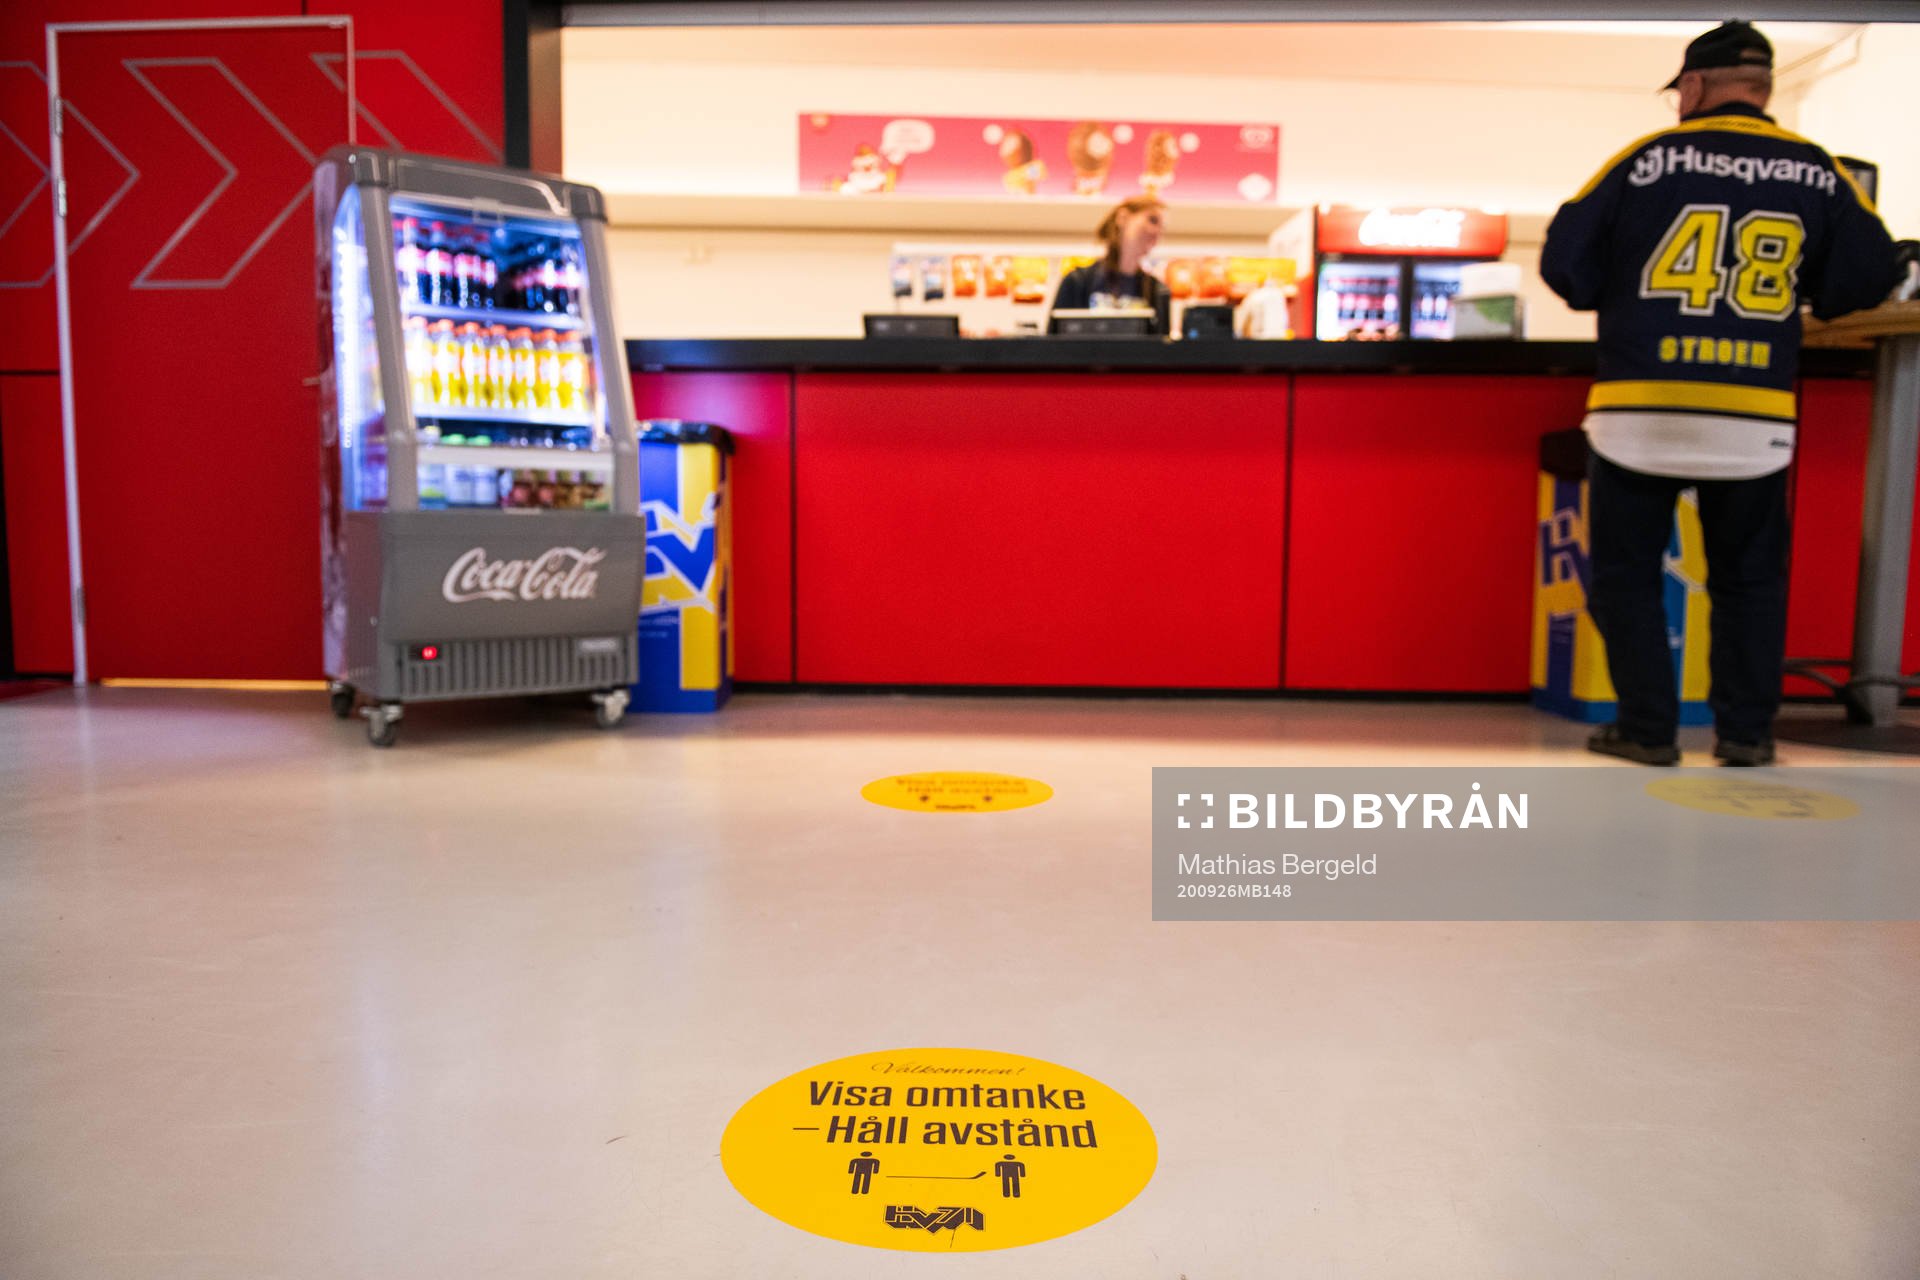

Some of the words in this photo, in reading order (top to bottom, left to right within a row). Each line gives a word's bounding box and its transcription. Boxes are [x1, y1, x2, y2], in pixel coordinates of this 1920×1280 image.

[1639, 204, 1806, 322] 48
[442, 547, 606, 603] Coca-Cola
[809, 1081, 892, 1106] Visa
[906, 1084, 1086, 1110] omtanke
[922, 1118, 1098, 1148] avstånd
